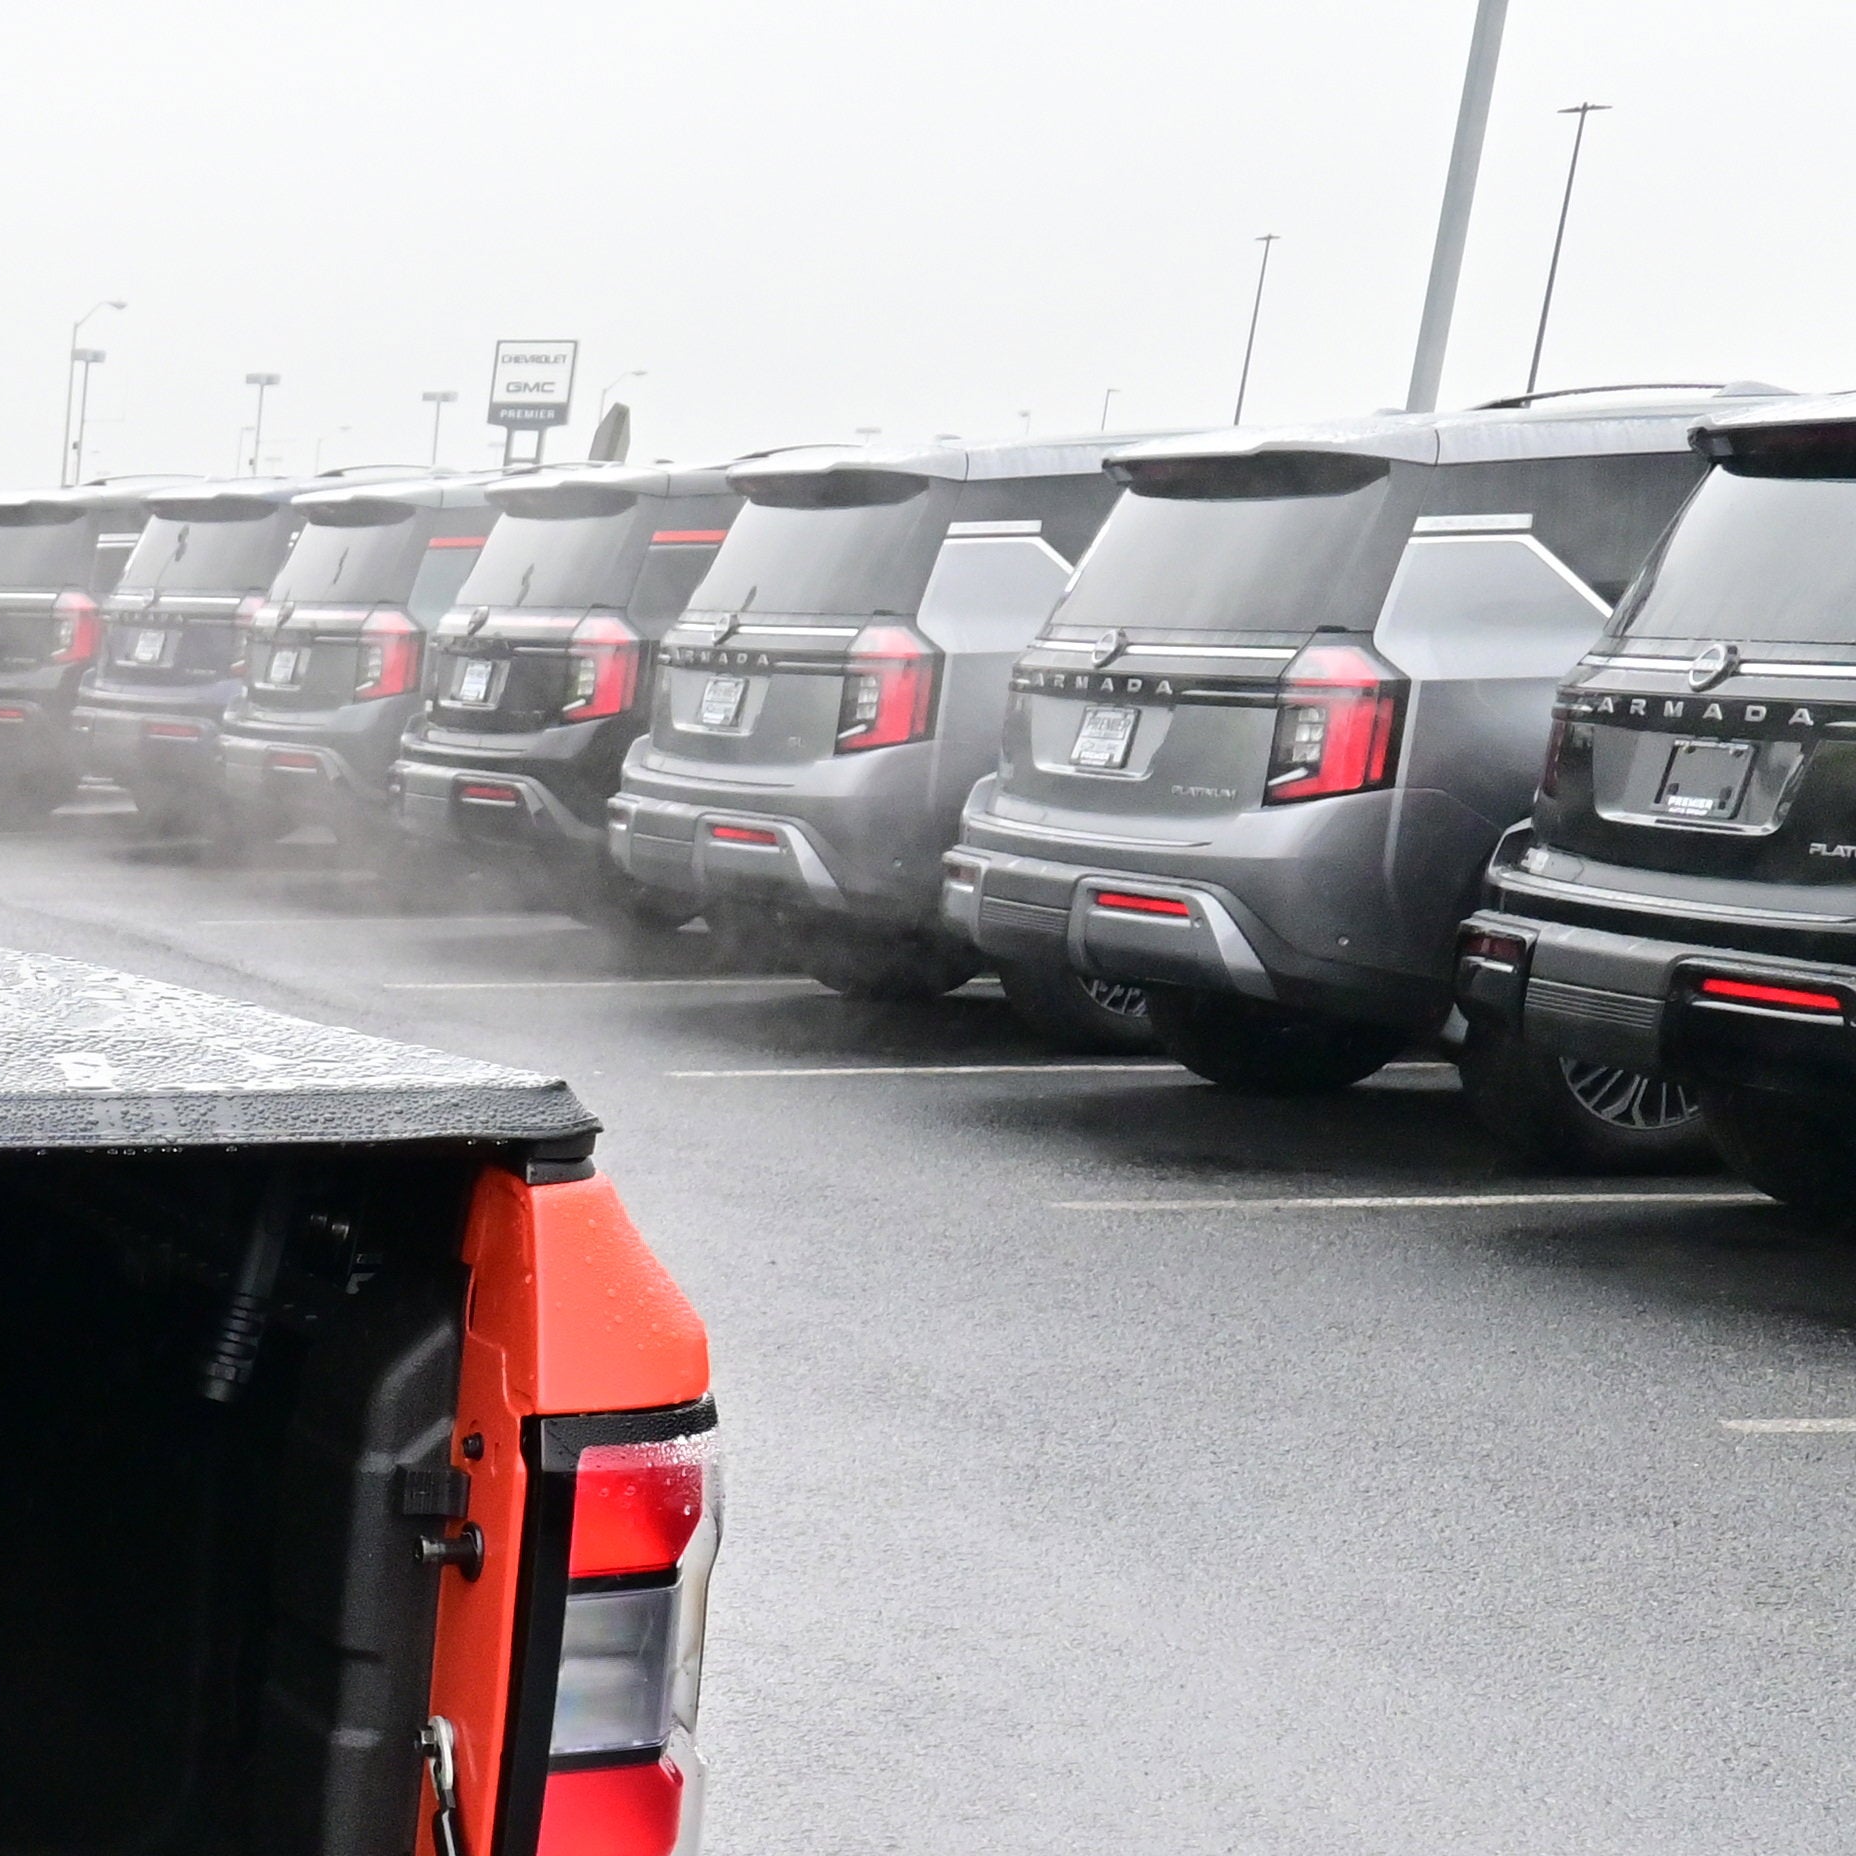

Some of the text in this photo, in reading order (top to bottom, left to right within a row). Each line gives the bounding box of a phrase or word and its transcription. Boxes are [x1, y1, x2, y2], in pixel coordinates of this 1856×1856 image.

[501, 354, 567, 364] CHEVROLET
[506, 381, 555, 393] GMC
[500, 408, 556, 419] PREMIER
[1038, 673, 1173, 695] ARMADA
[1597, 697, 1814, 726] ARMADA
[1171, 785, 1237, 799] PLATINUM
[1668, 794, 1713, 811] PREMIER
